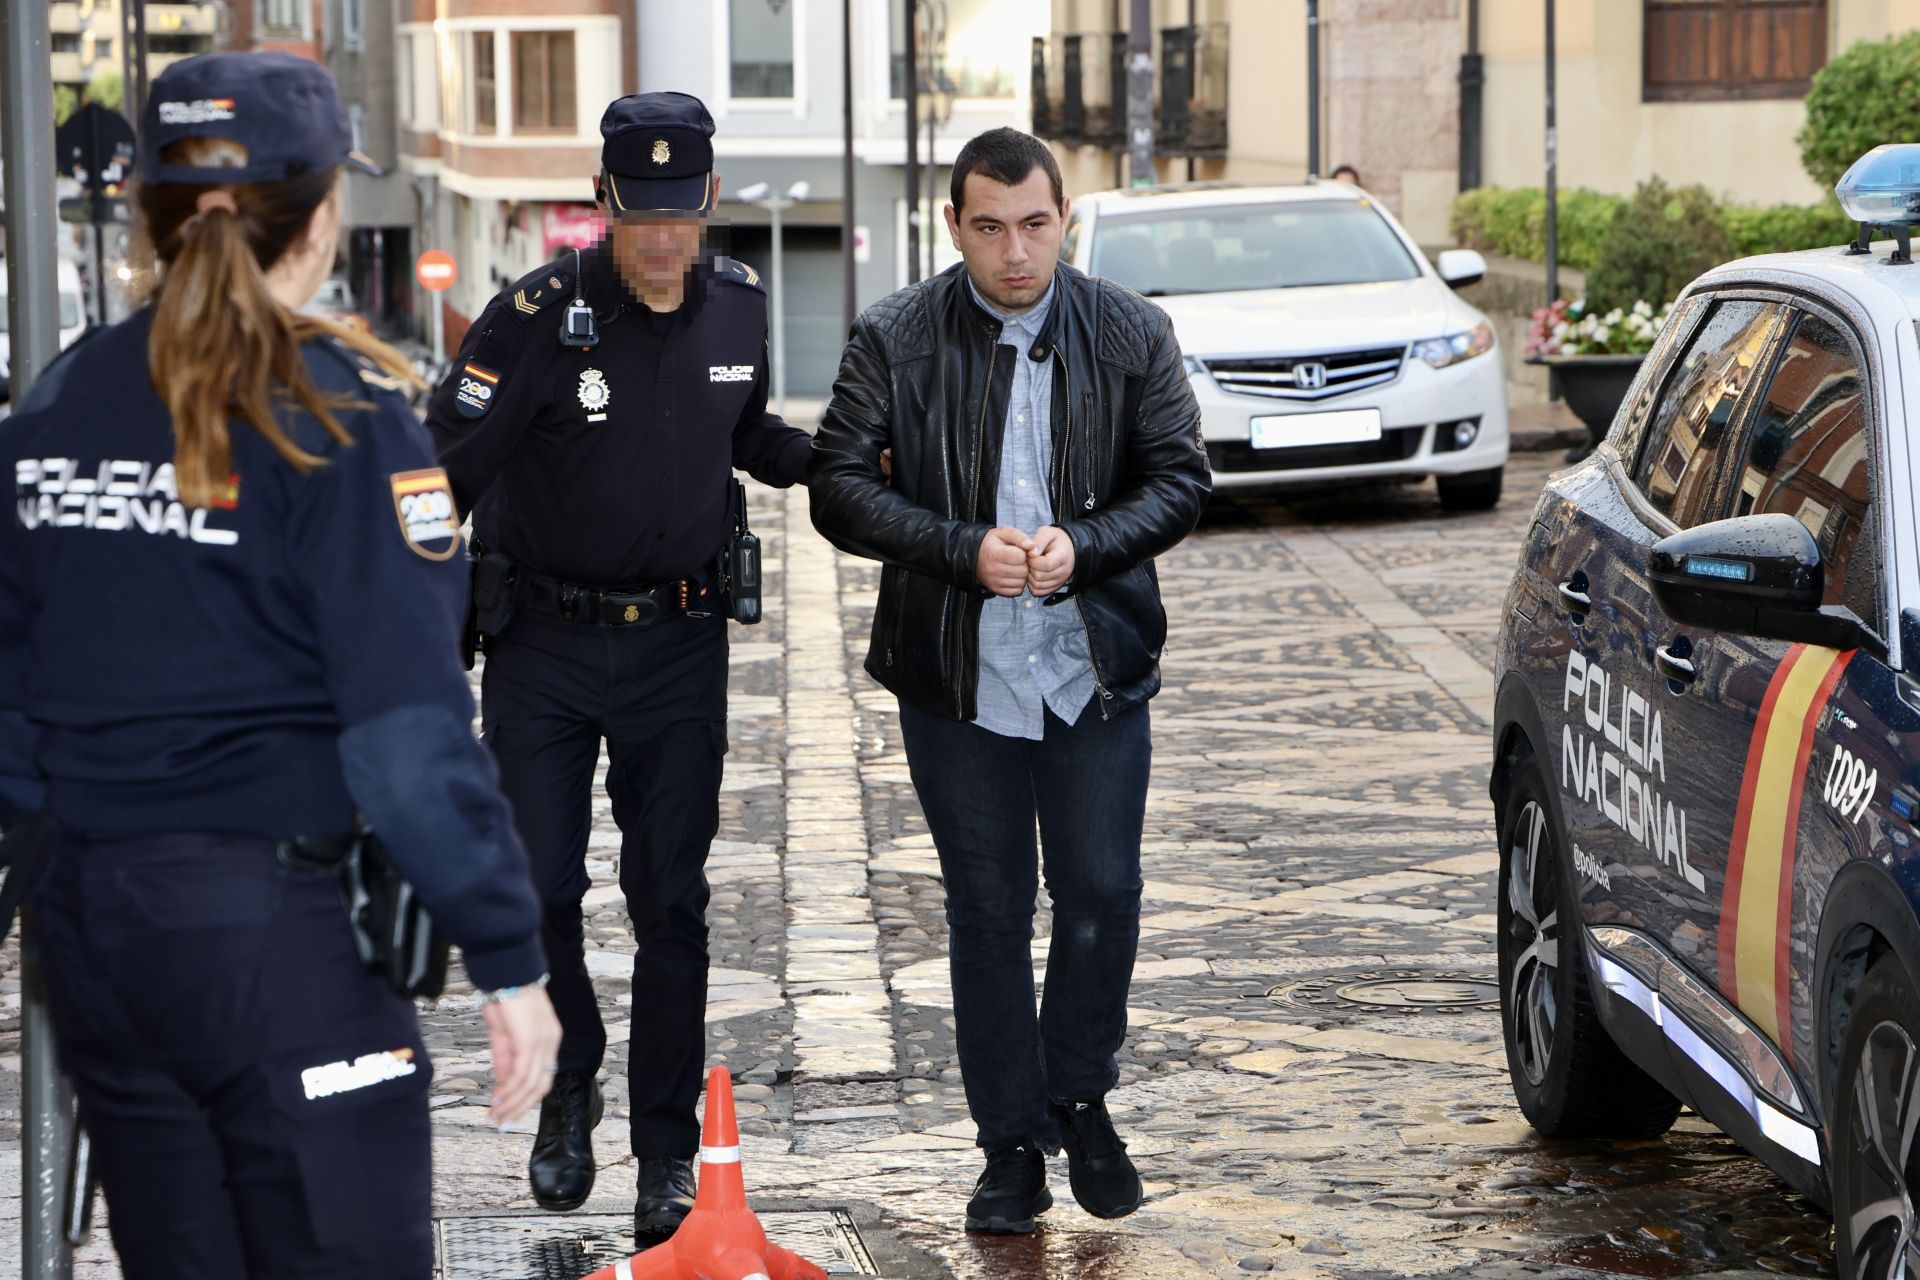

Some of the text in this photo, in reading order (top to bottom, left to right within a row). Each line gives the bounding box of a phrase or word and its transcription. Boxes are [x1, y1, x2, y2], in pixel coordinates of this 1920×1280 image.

[459, 377, 492, 400] 200
[710, 373, 752, 382] NACIONAL
[15, 457, 180, 501] POLICIA
[17, 493, 239, 545] NACIONAL
[1563, 648, 1666, 783] POLICIA
[1562, 723, 1706, 894] NACIONAL
[1573, 842, 1612, 892] @policia
